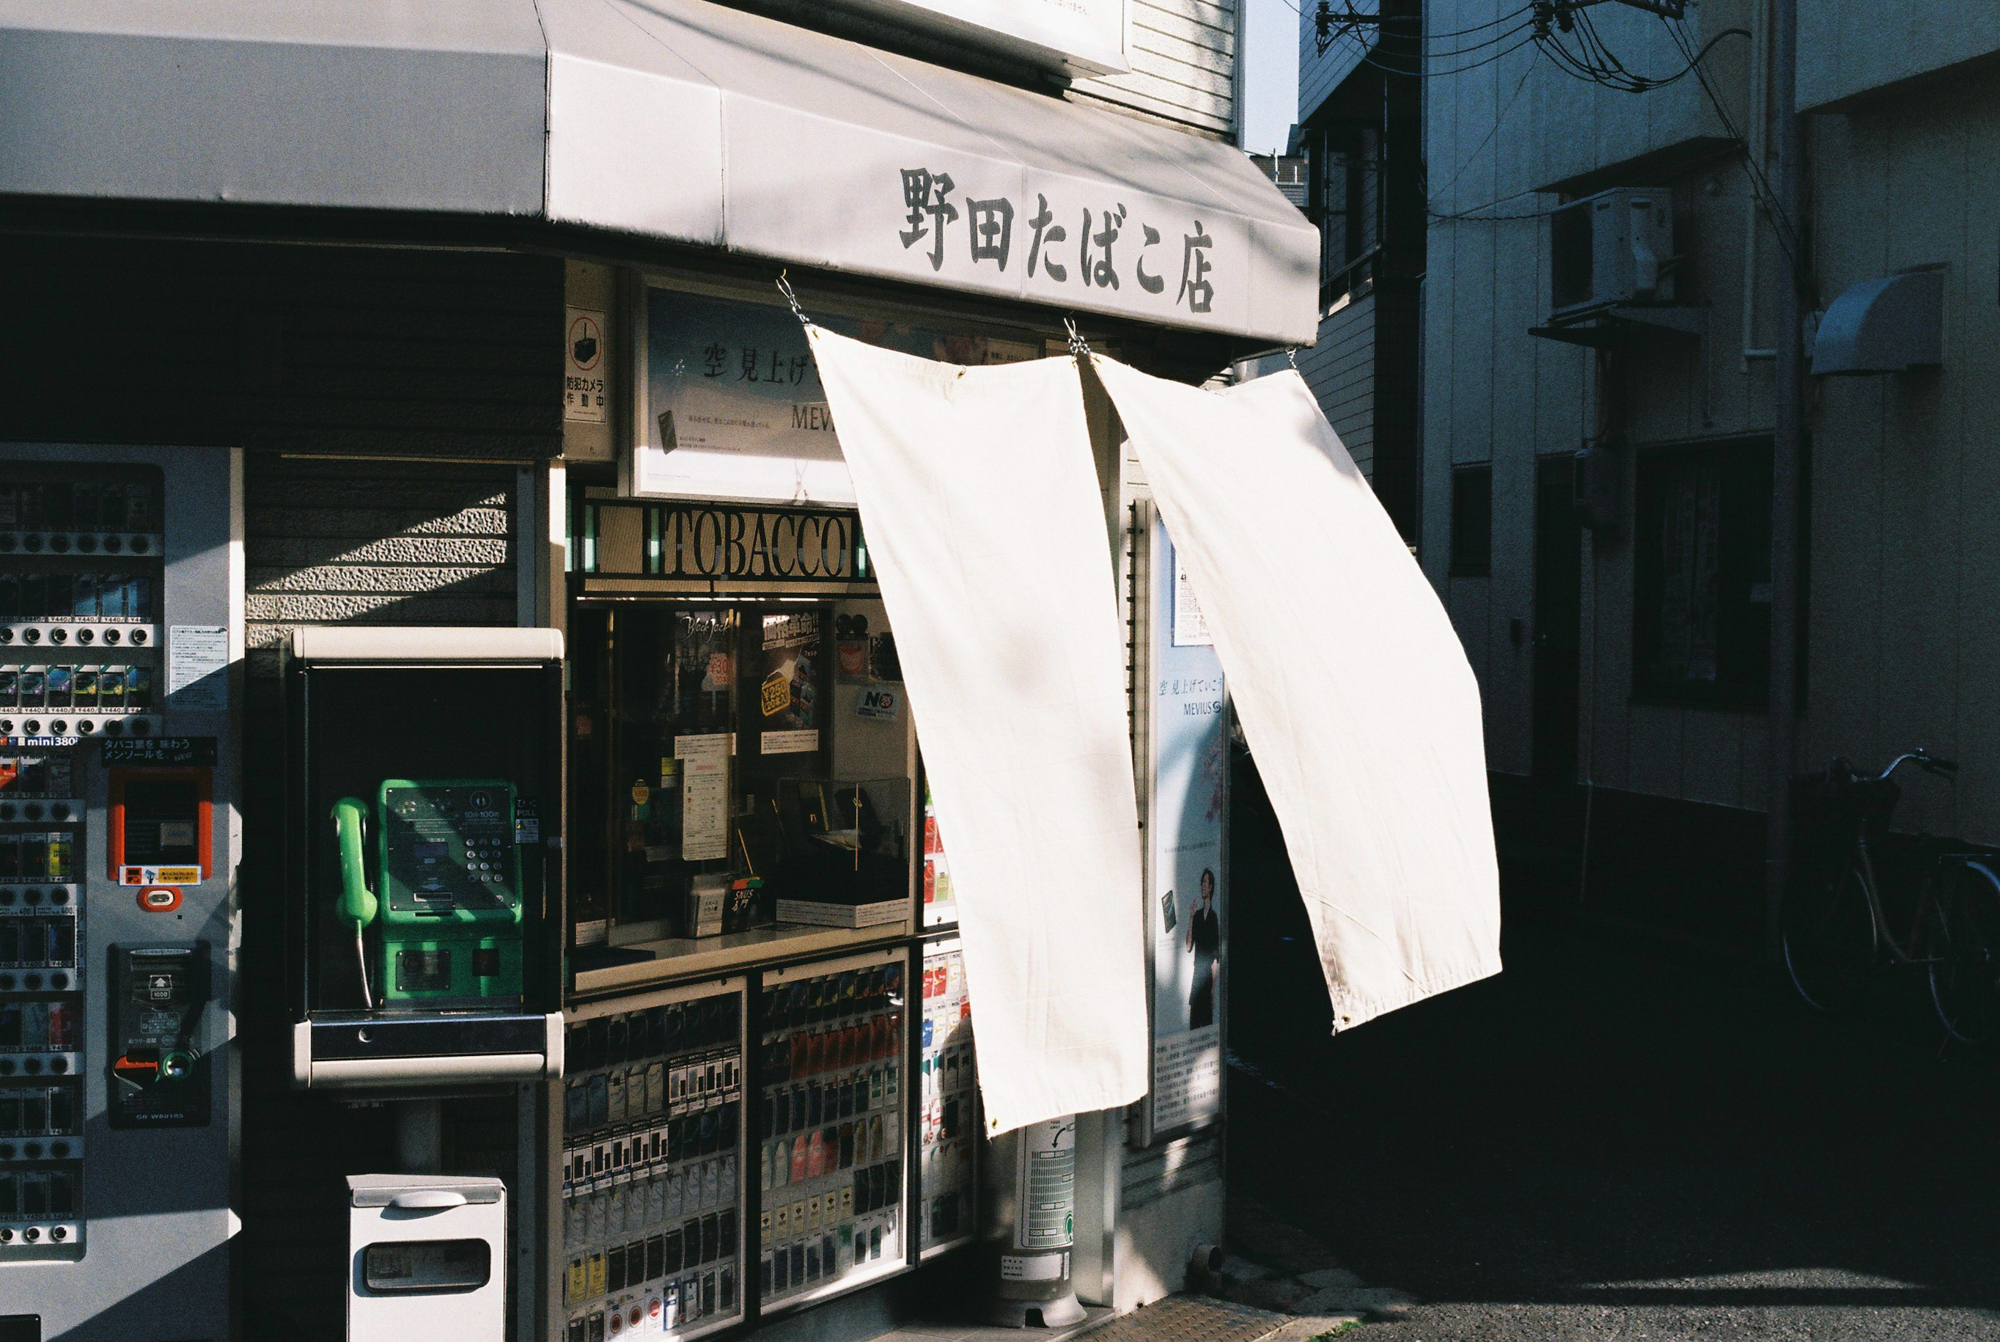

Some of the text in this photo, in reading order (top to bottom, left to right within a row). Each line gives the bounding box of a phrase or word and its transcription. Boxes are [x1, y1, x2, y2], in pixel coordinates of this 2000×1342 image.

[899, 167, 1216, 314] 野田たばこ店
[567, 376, 604, 393] 防犯カメラ
[665, 508, 847, 577] TOBACCO
[1184, 702, 1212, 716] MEVIUS
[516, 809, 537, 817] PULL
